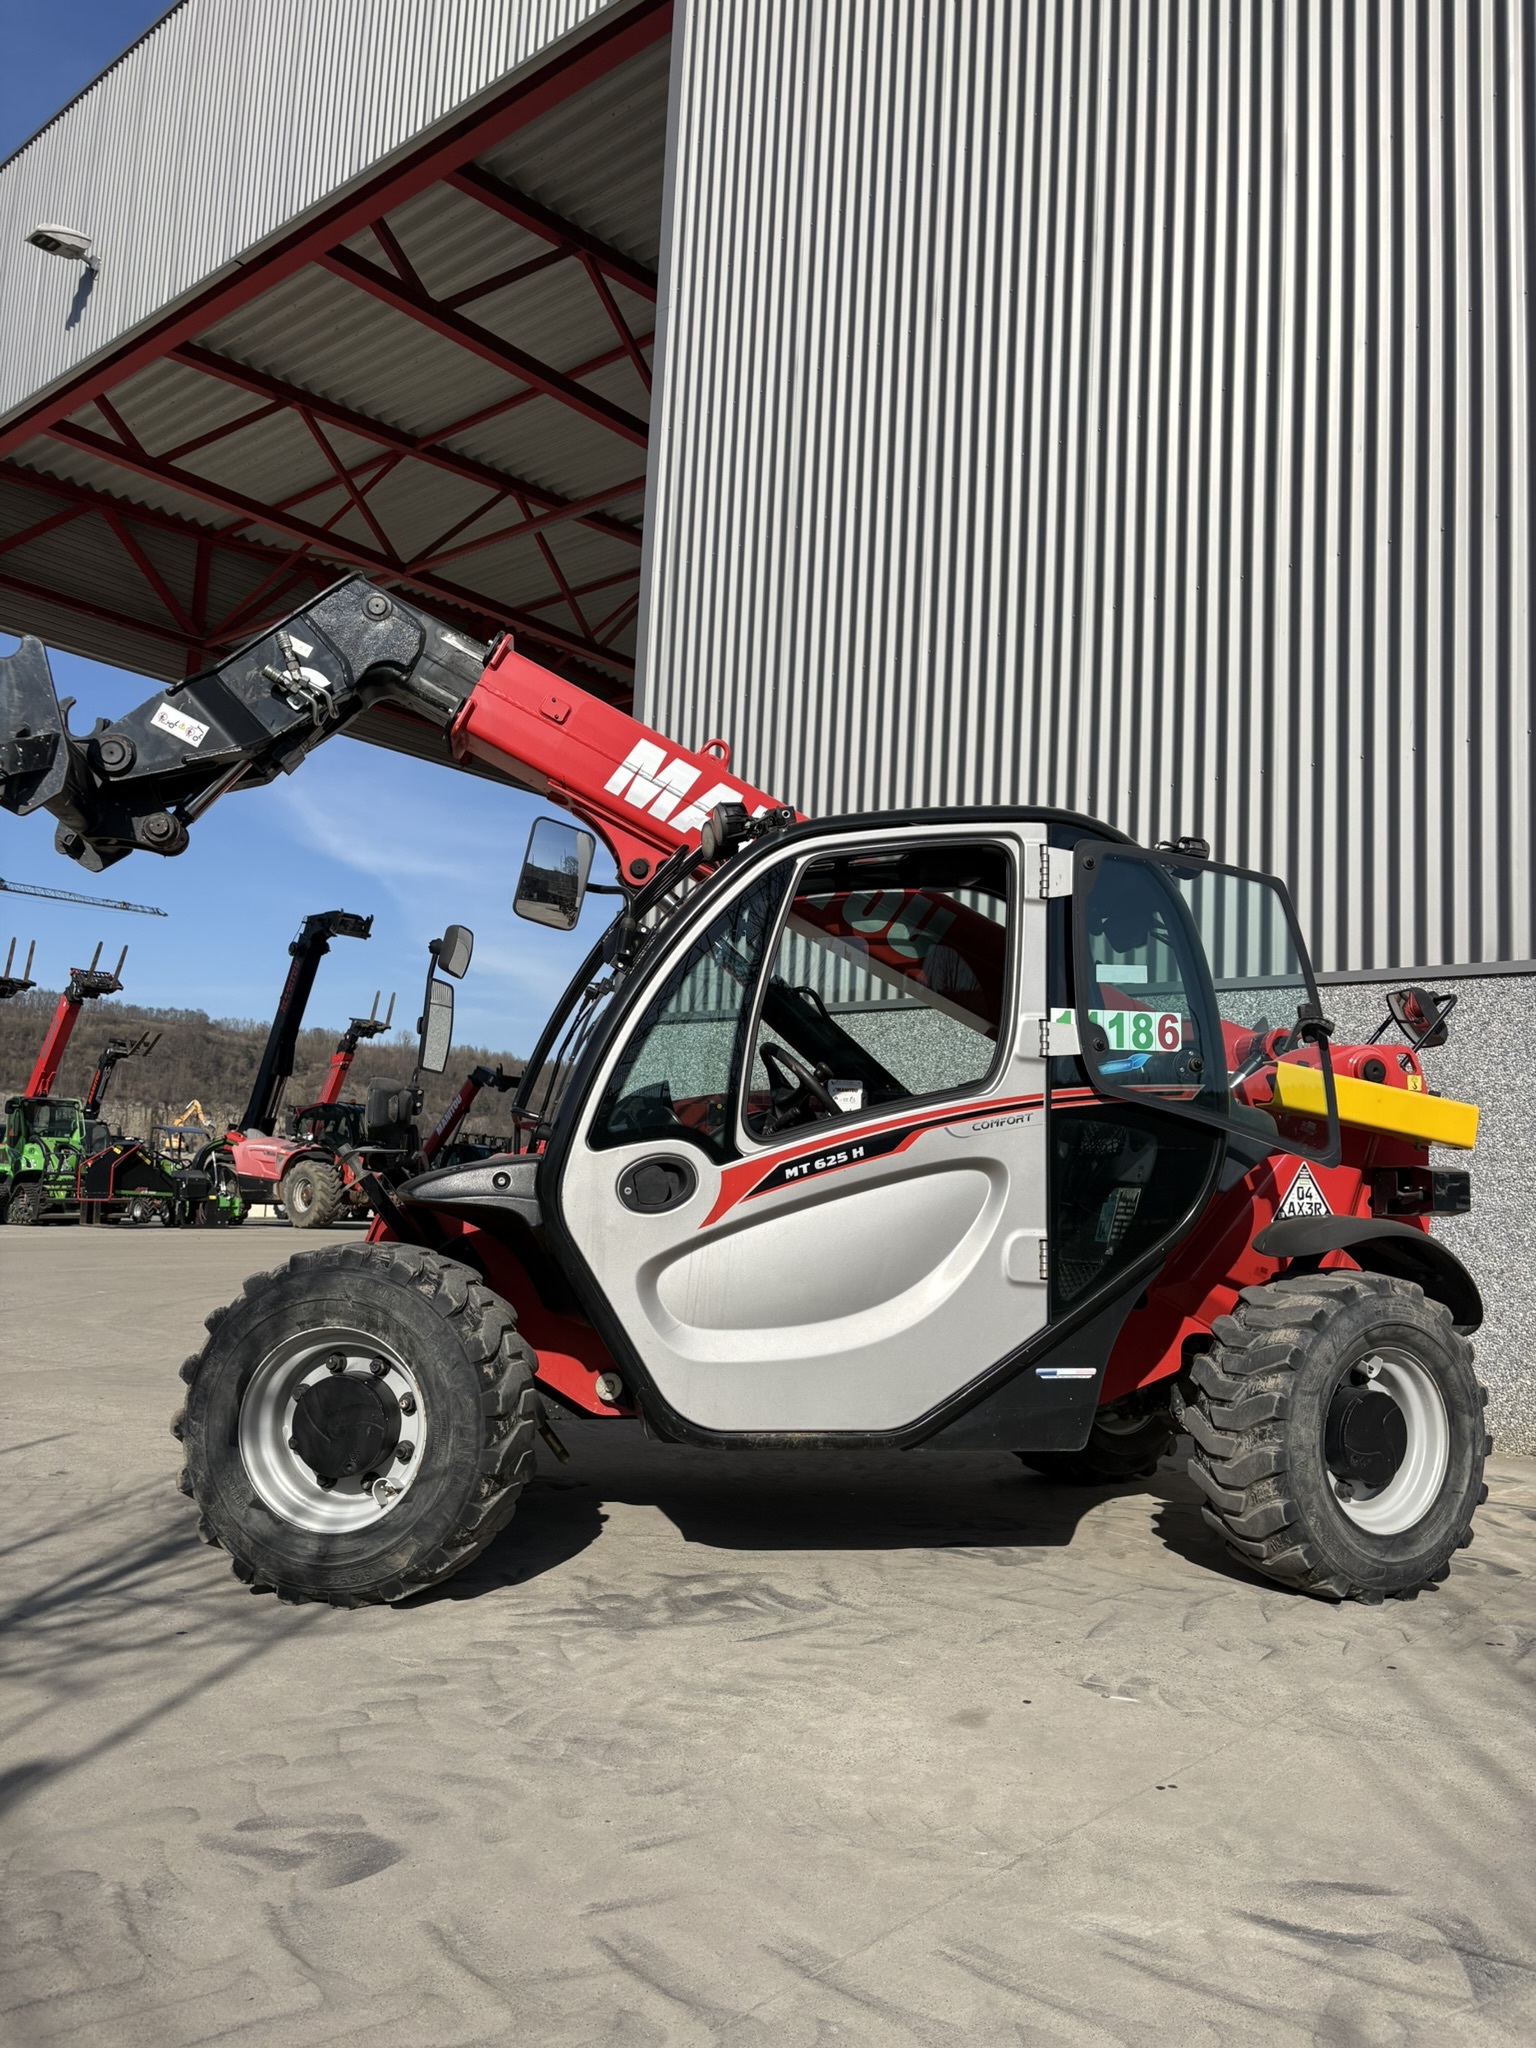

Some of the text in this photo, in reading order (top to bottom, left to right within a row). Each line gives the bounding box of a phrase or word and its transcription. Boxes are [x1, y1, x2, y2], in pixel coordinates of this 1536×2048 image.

[435, 1093, 463, 1136] MANITOU
[972, 1112, 1034, 1131] COMFORT
[785, 1146, 865, 1180] MT 625 H
[1288, 1201, 1322, 1217] AX3R
